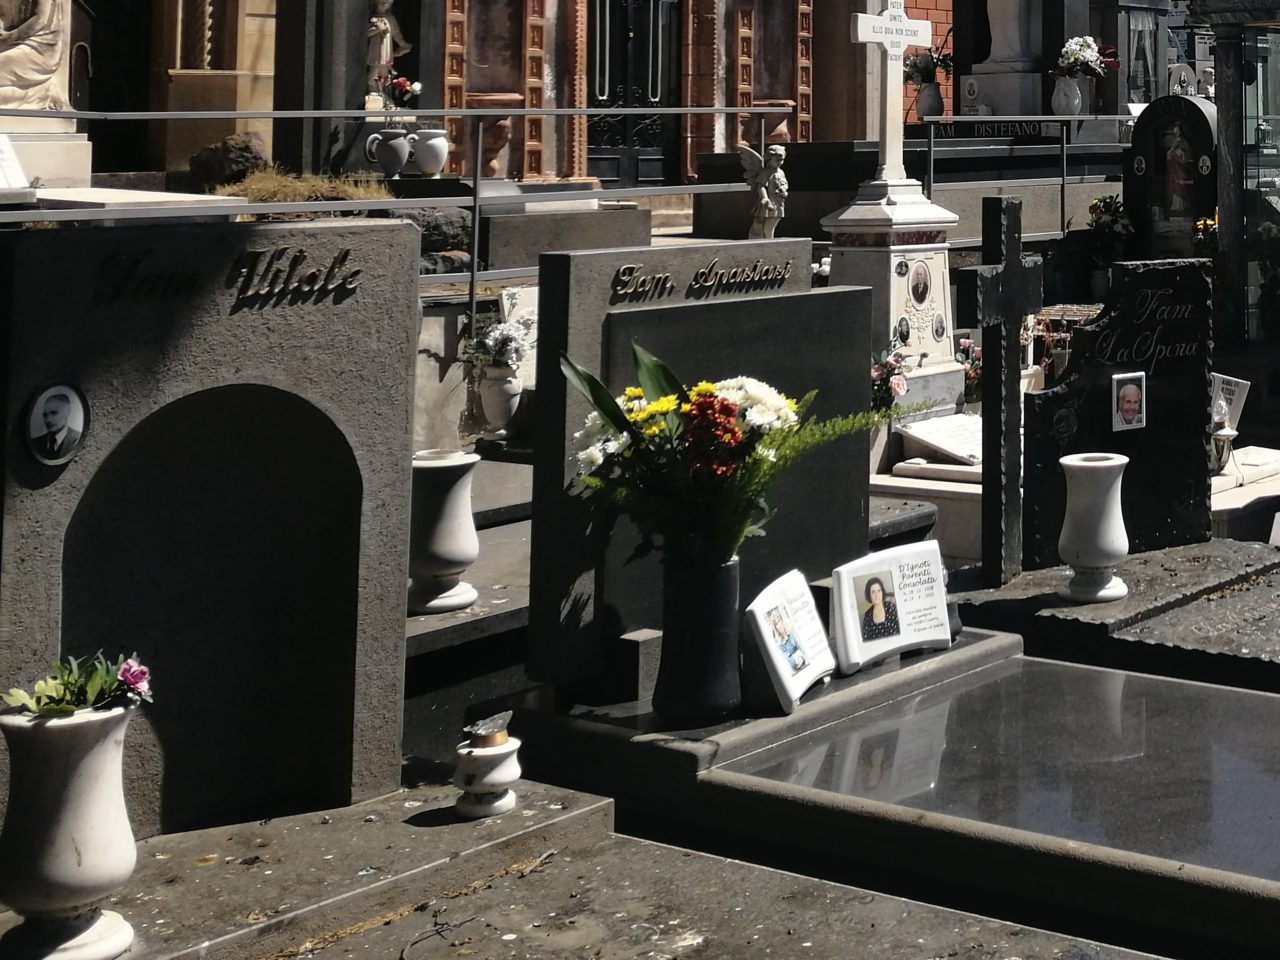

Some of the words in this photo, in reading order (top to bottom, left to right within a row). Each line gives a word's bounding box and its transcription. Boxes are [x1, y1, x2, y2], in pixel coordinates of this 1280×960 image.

[973, 121, 1040, 137] DISTEFANO
[234, 244, 364, 301] Vitale
[690, 256, 791, 290] Anastasi
[1132, 288, 1193, 325] Fam
[898, 577, 937, 590] Consolata
[901, 568, 931, 581] Parenti
